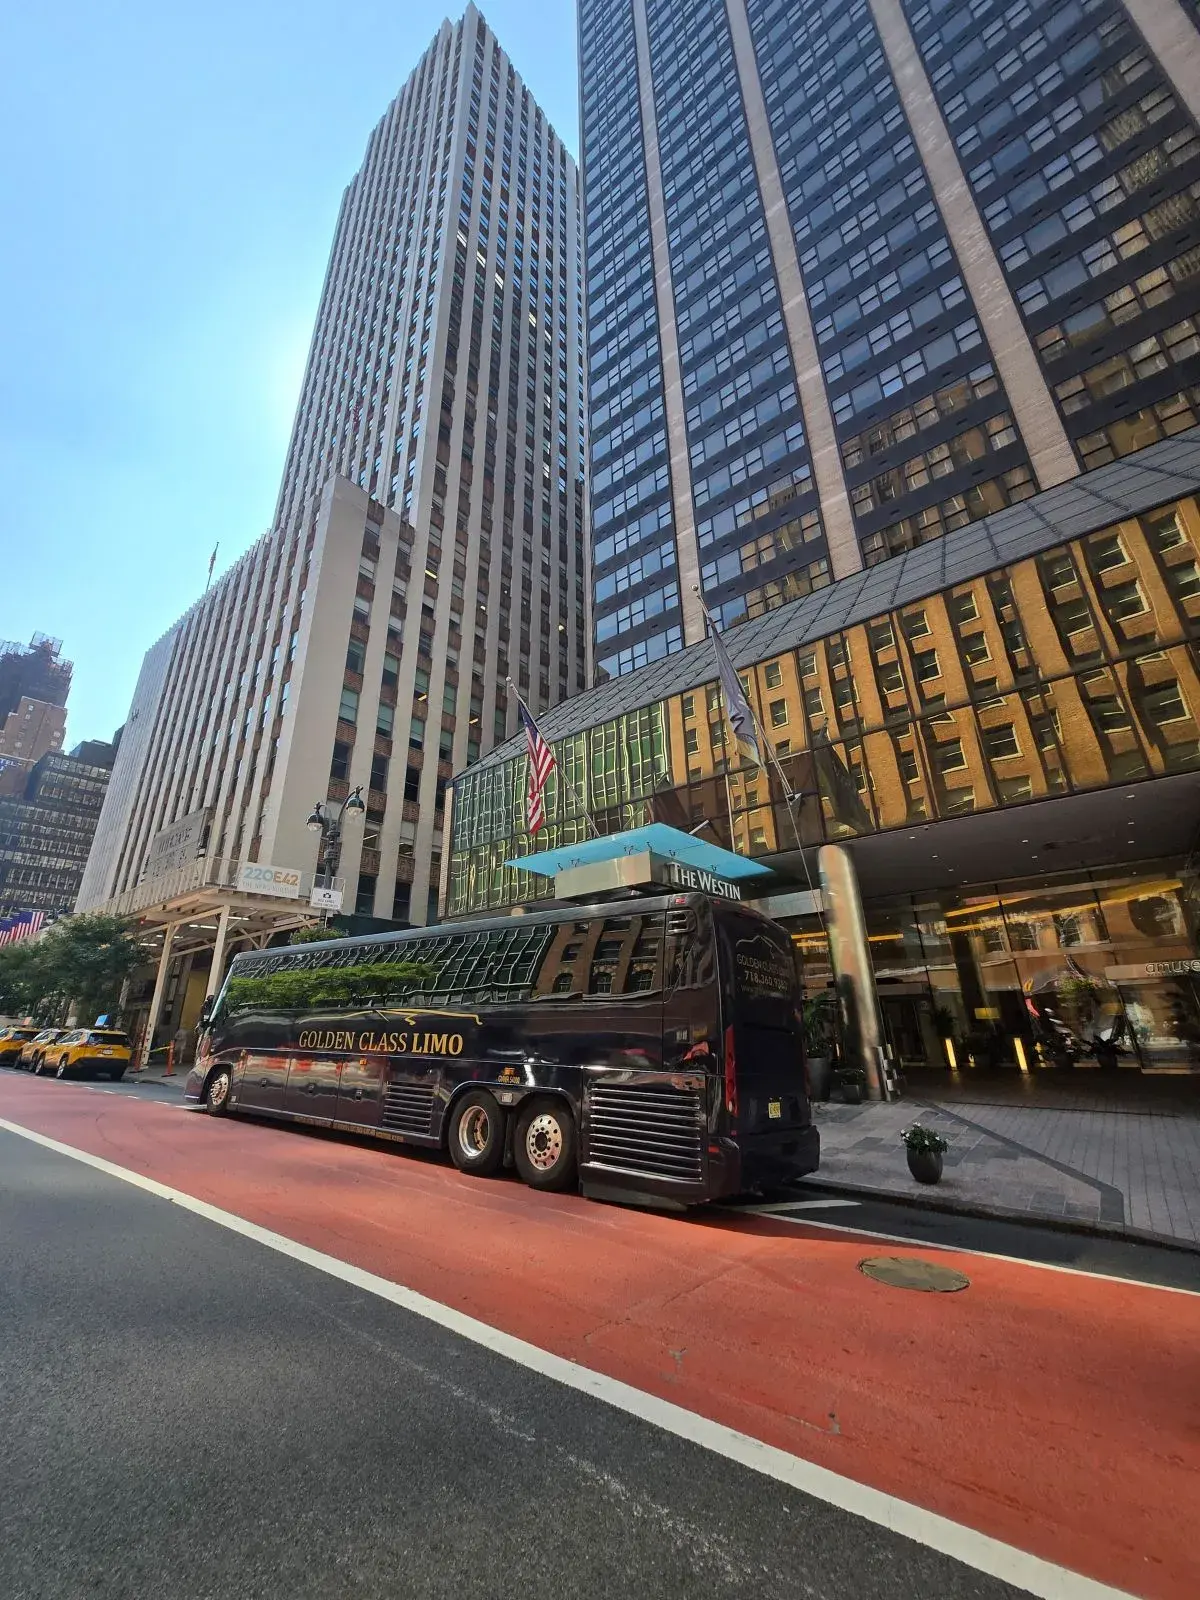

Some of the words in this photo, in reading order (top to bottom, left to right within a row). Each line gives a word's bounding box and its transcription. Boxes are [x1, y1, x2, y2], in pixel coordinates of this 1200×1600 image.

[244, 867, 299, 886] 220E42
[667, 861, 697, 889] THE
[697, 870, 741, 900] WESTIN
[299, 1031, 355, 1050] GOLDEN
[359, 1032, 408, 1052] CLASS
[411, 1033, 464, 1055] LIMO
